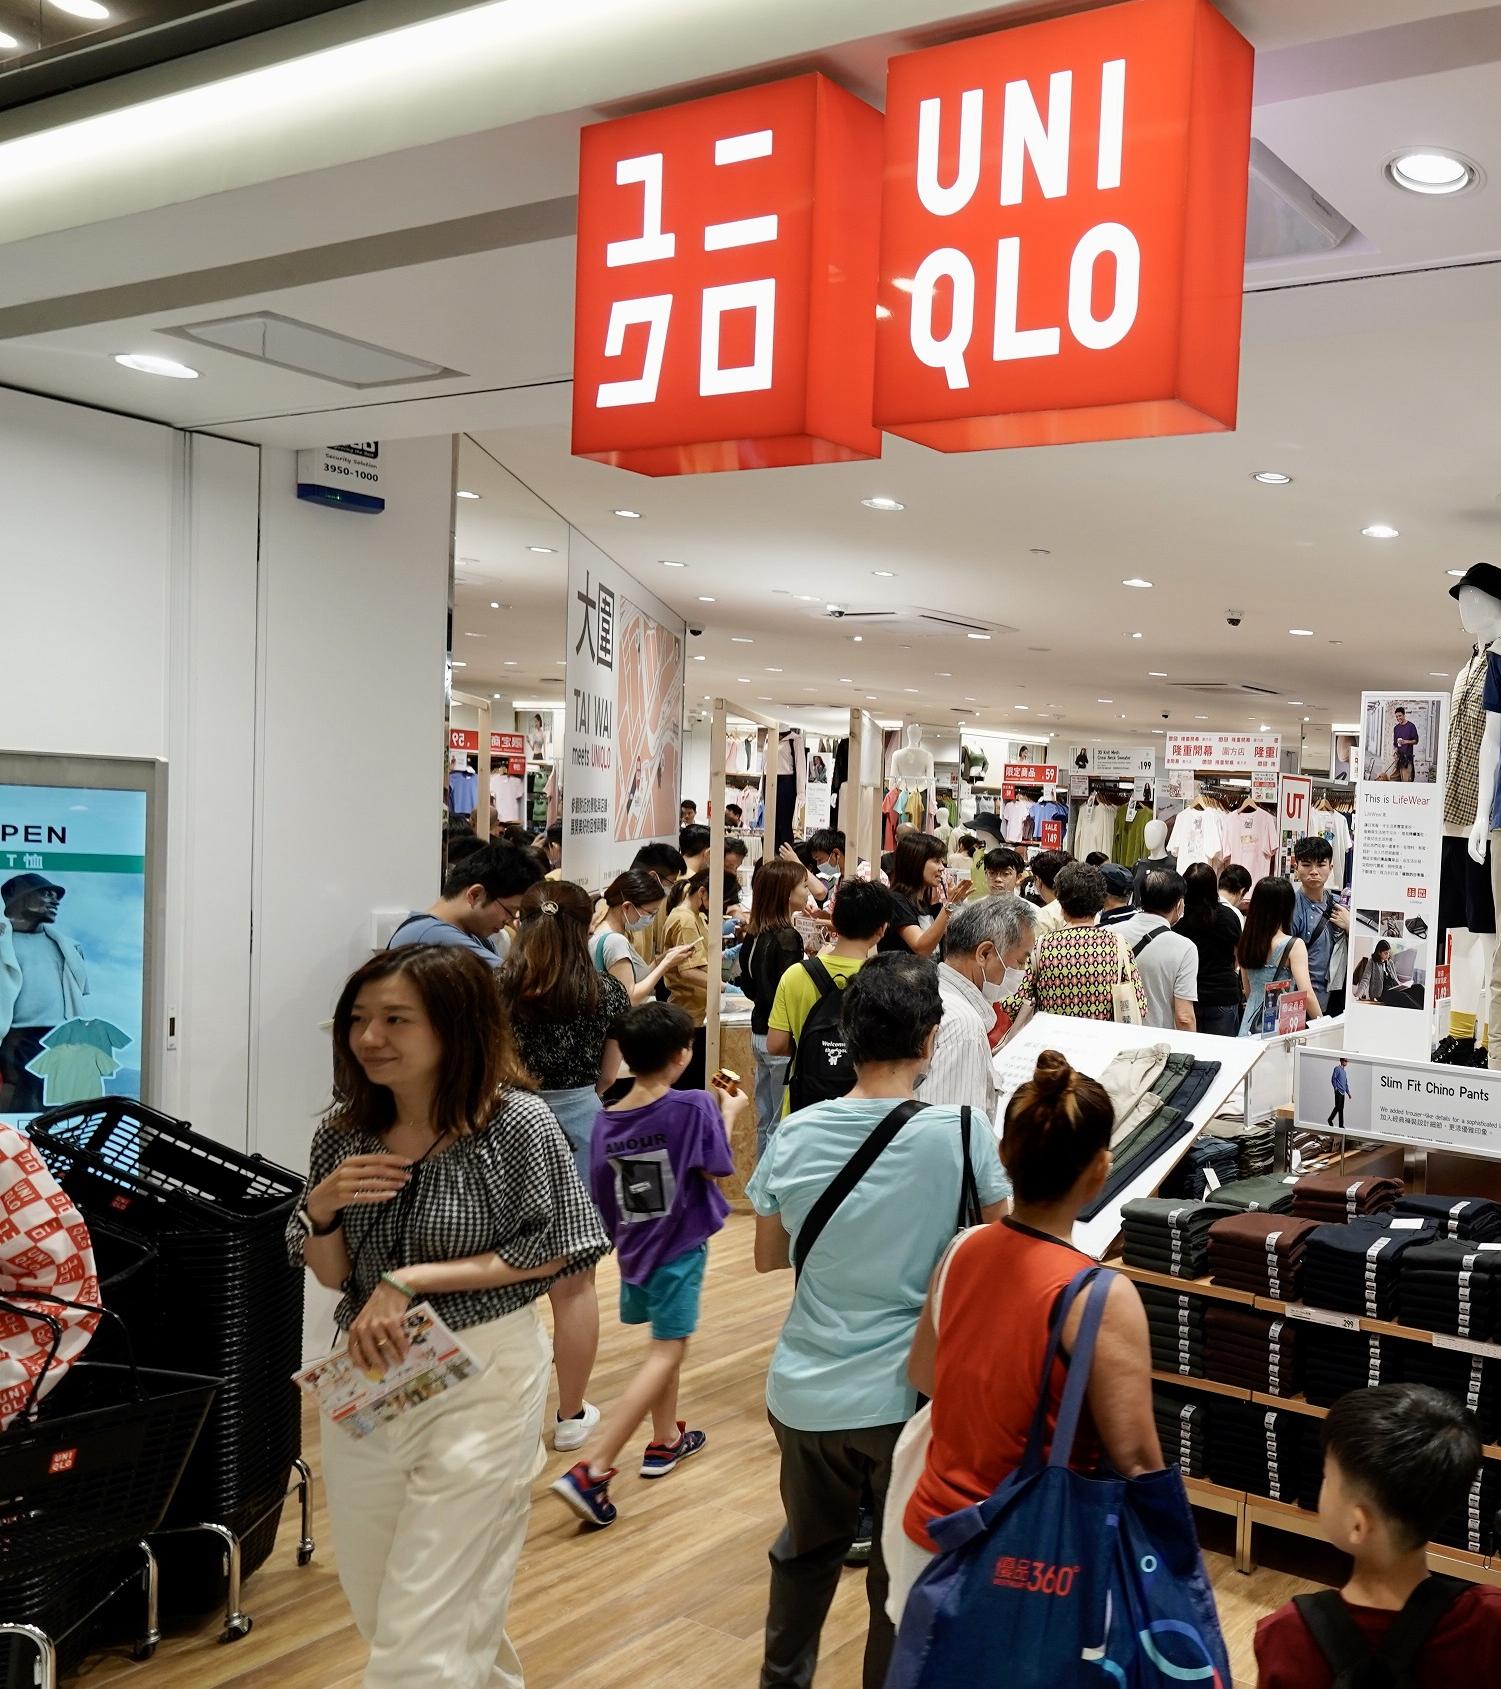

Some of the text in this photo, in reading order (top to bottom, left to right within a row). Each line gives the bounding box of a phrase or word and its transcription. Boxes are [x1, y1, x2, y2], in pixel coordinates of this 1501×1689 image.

[916, 58, 1127, 217] UNI
[606, 129, 778, 268] ユニ
[909, 222, 1142, 390] QLO
[596, 277, 777, 409] クロ
[325, 453, 378, 470] Security Solution
[323, 463, 379, 482] 3950-1000
[575, 569, 615, 672] 大圍
[574, 688, 612, 740] TAI WAI
[572, 742, 612, 772] meets UNIQLO
[1173, 745, 1213, 756] 隆重開幕
[1254, 746, 1278, 758] 隆重
[1005, 766, 1036, 778] 限定商品
[1364, 794, 1430, 805] This is LifeWear
[1045, 821, 1057, 831] SALE
[1380, 1075, 1489, 1101] Slim Fit Chino Pants
[1390, 1107, 1404, 1115] added
[1435, 1113, 1450, 1122] details
[1452, 1115, 1460, 1123] for
[1466, 1117, 1498, 1129] sophisticated
[606, 1134, 666, 1154] AMOUR
[51, 1459, 72, 1471] QLO
[53, 1452, 72, 1462] UNI
